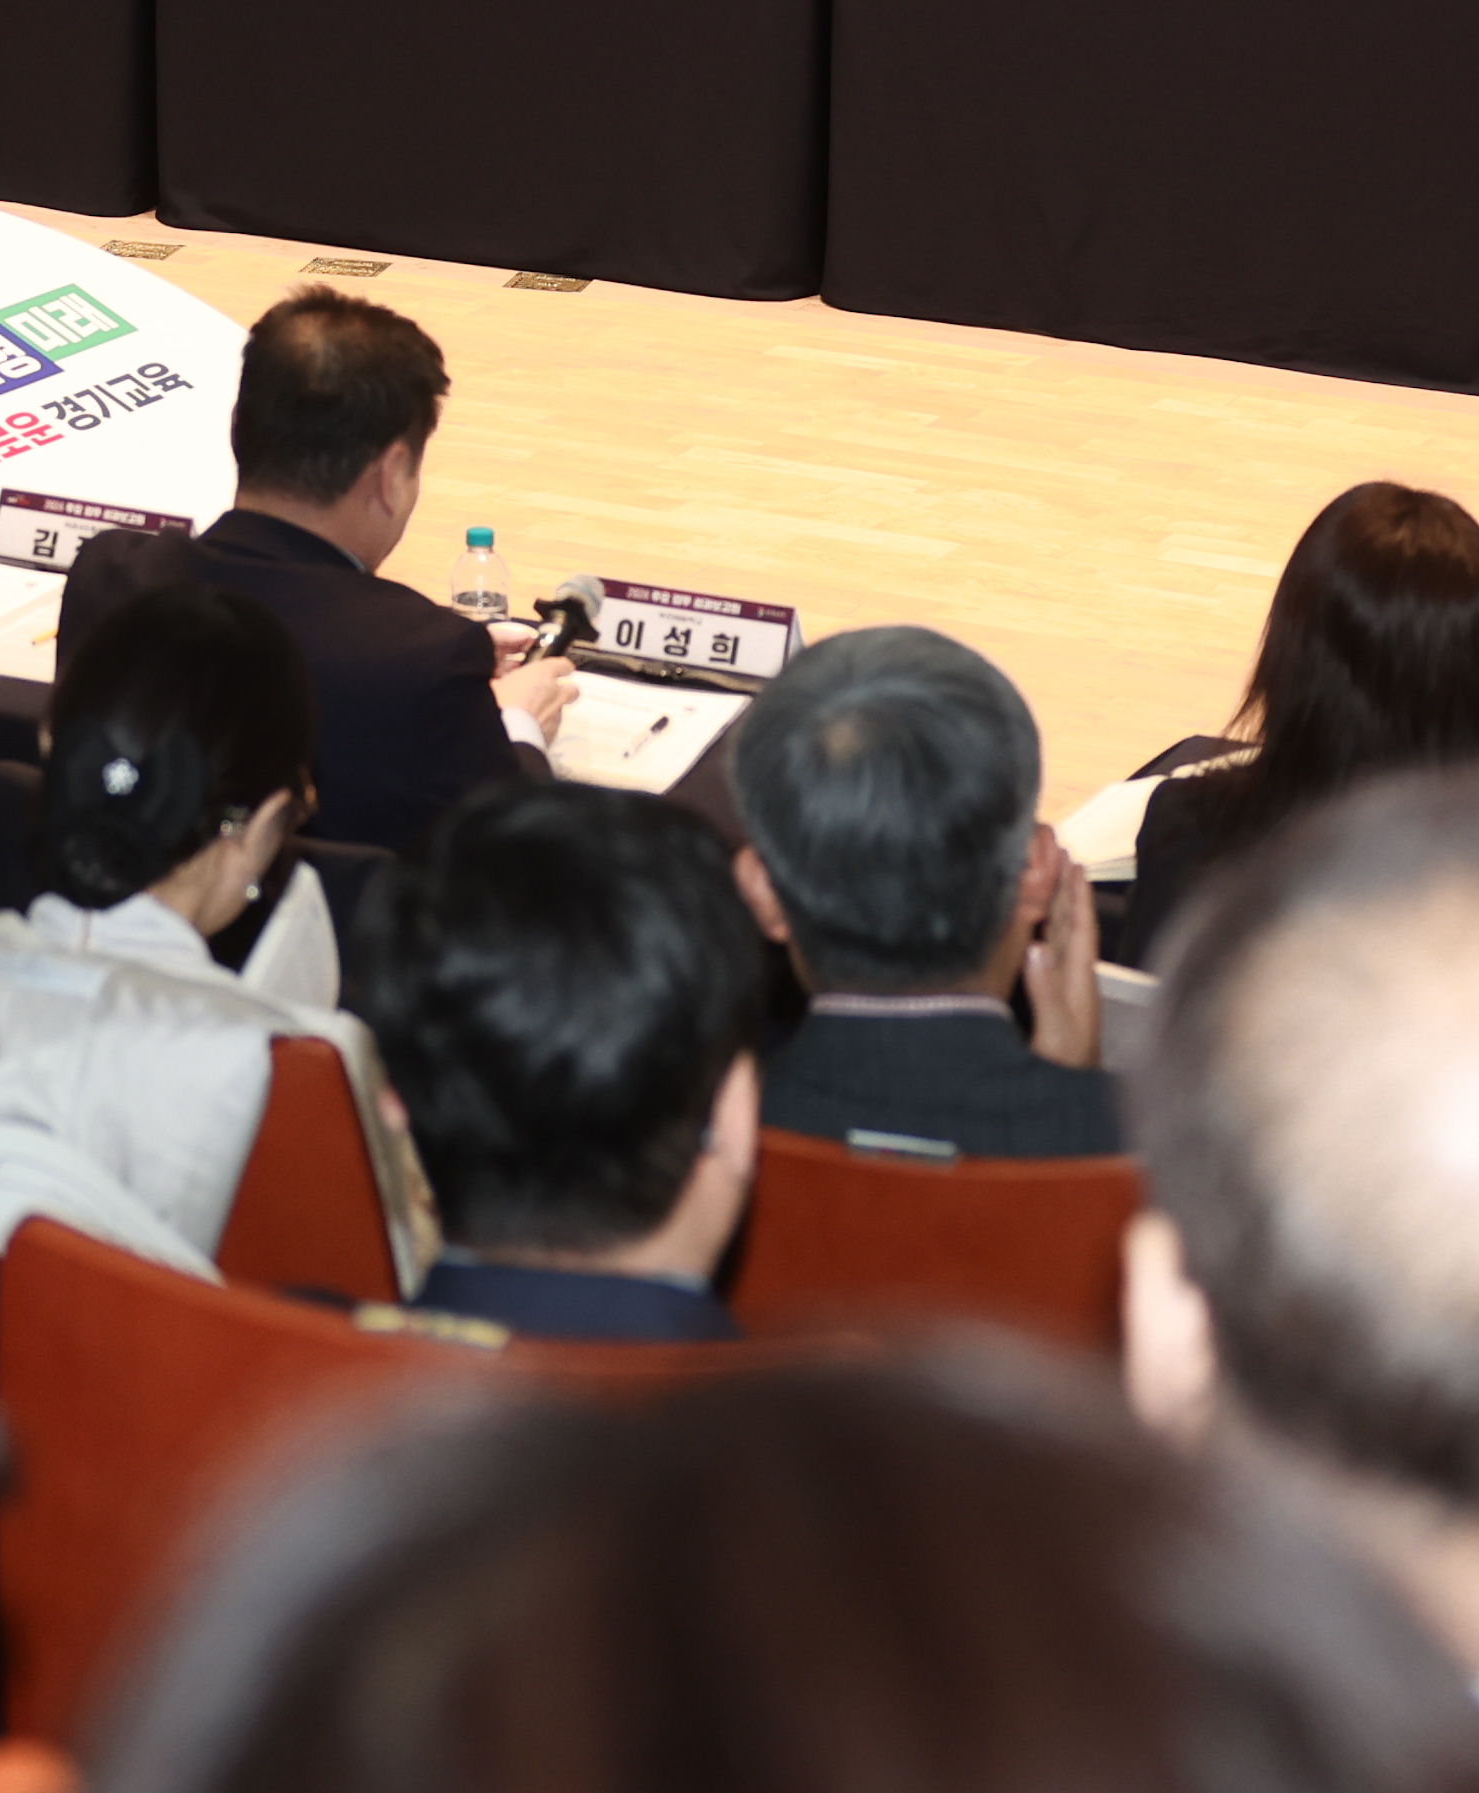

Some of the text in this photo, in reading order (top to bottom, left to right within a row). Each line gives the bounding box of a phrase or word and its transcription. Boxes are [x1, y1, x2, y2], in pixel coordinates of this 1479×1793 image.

[4, 292, 121, 353] 미래
[40, 362, 195, 431] 경기교육
[616, 619, 740, 665] 이성희
